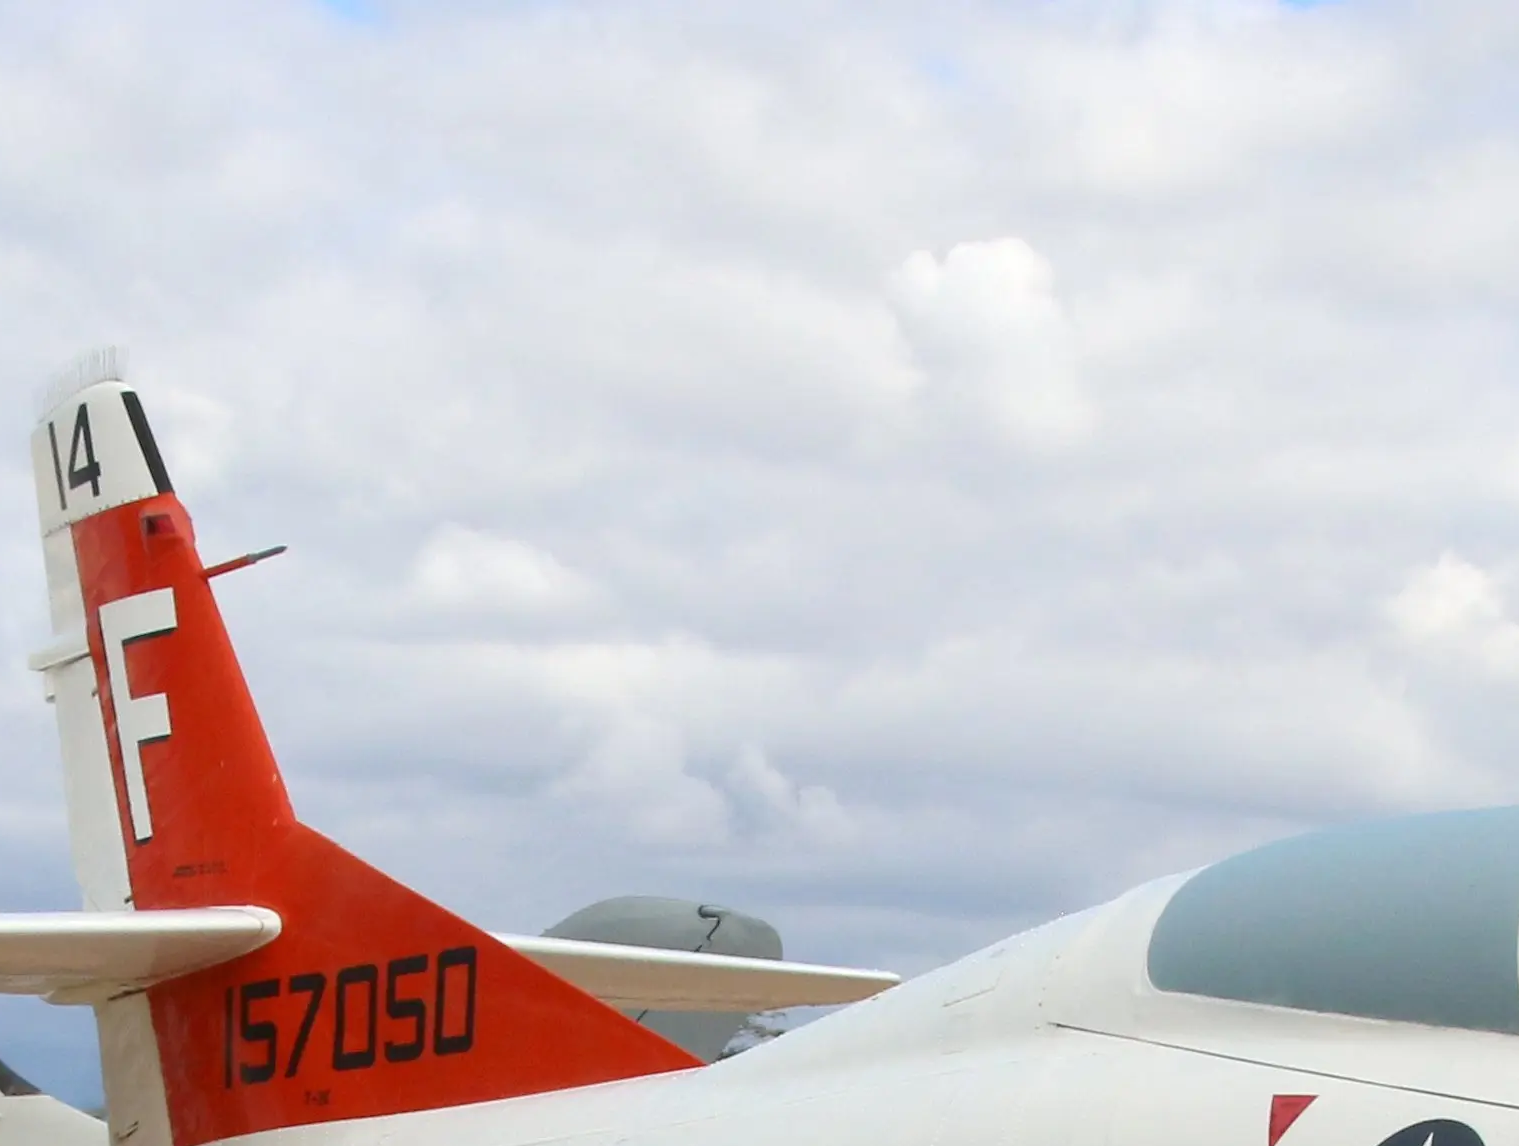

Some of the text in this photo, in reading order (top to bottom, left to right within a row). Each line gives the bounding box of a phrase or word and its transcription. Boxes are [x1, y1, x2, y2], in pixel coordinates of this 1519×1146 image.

[47, 402, 101, 510] 14
[97, 587, 178, 845] F
[224, 945, 477, 1089] 157050
